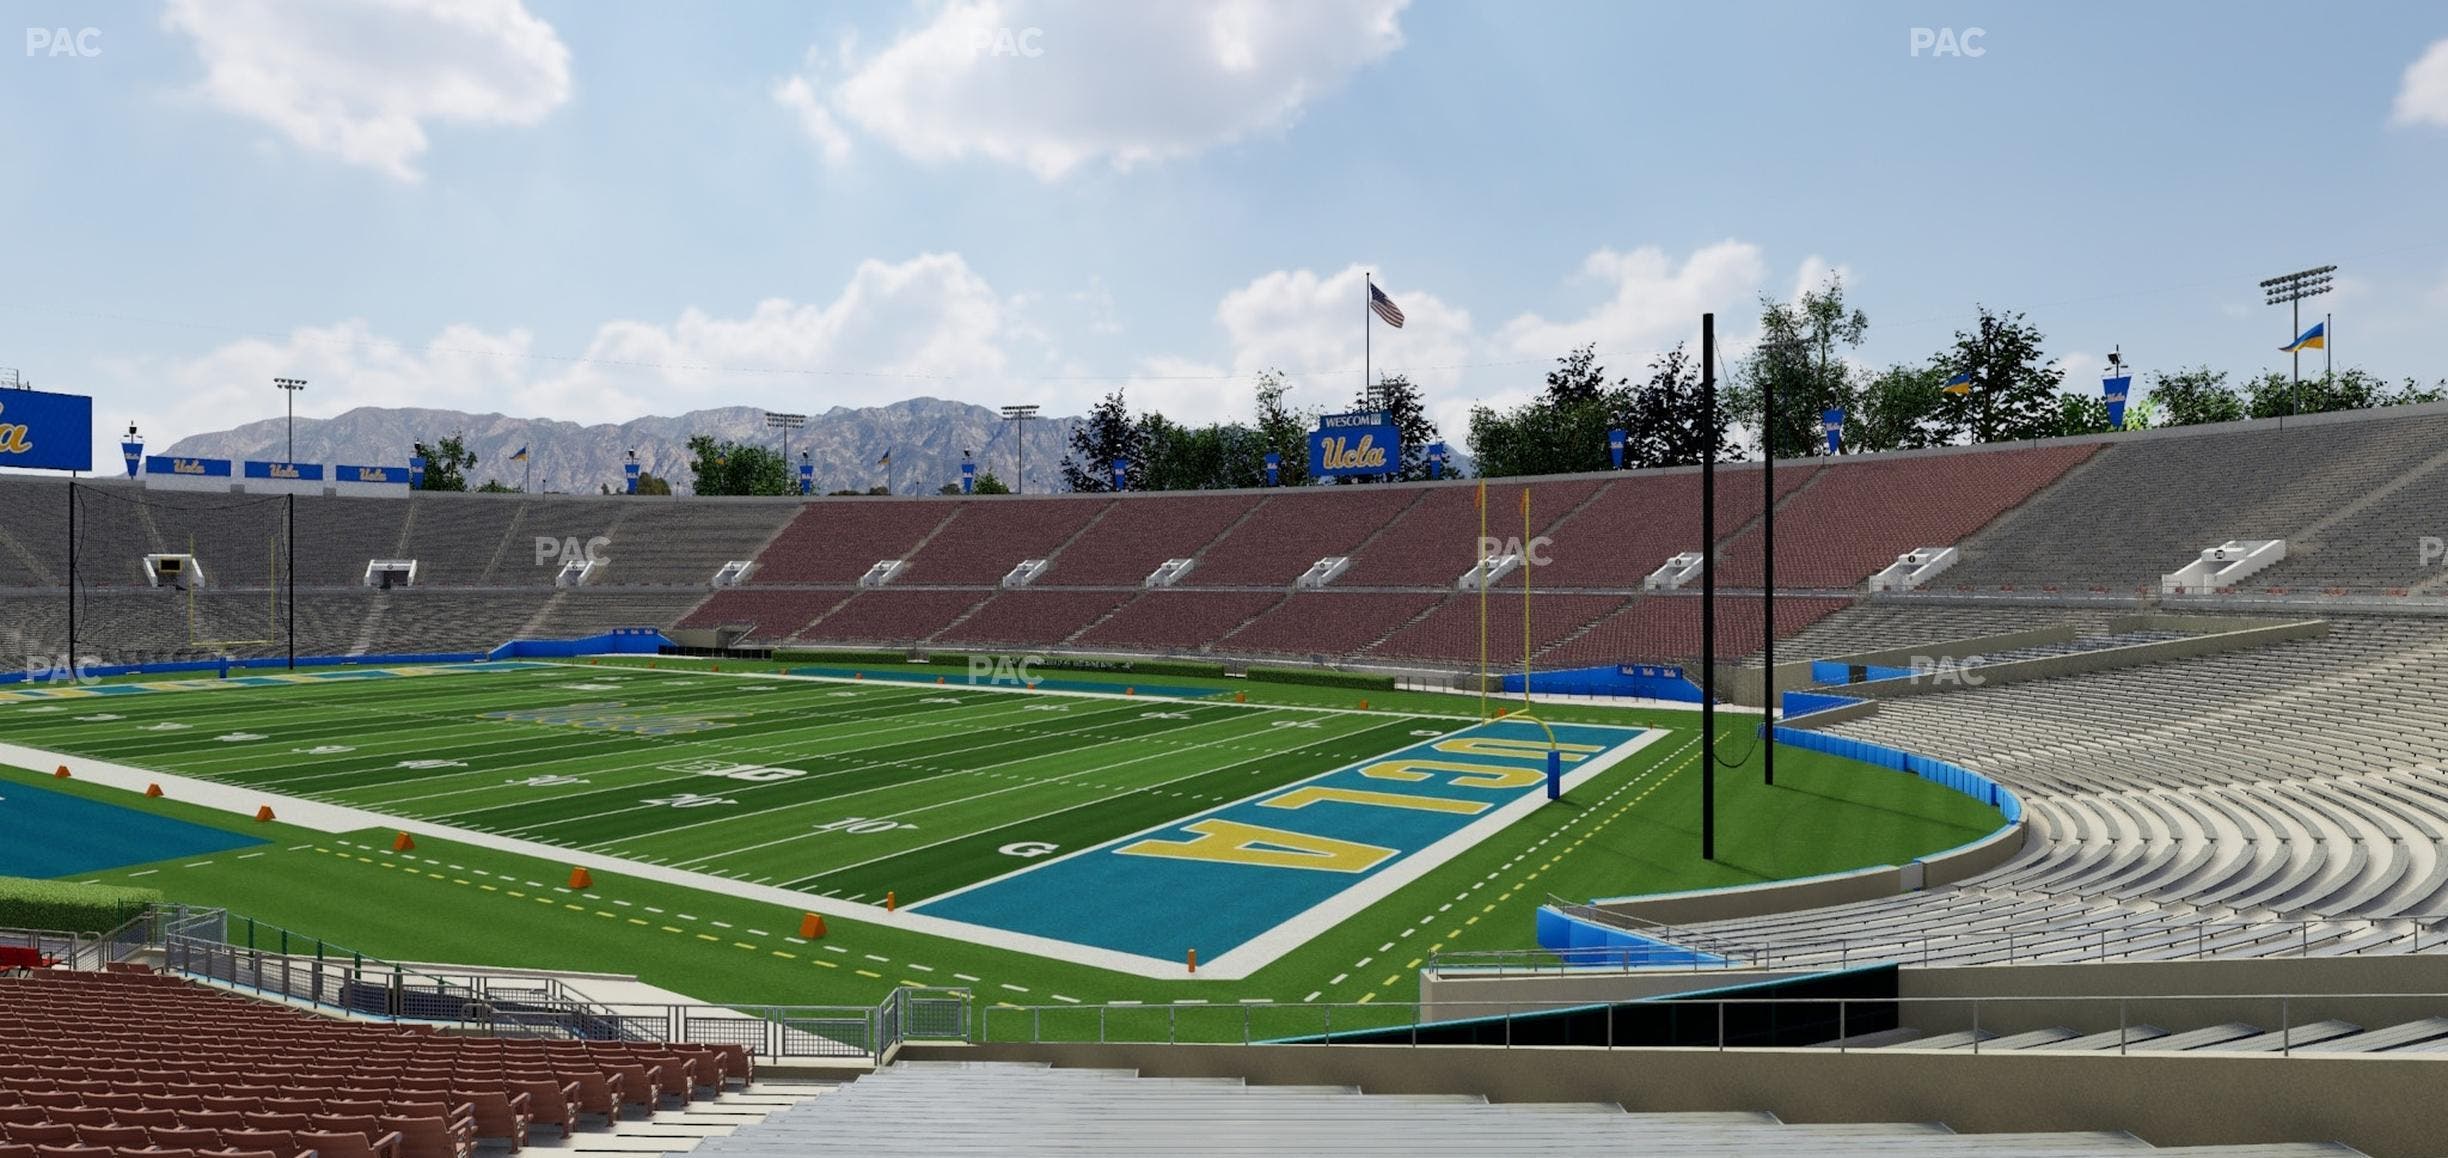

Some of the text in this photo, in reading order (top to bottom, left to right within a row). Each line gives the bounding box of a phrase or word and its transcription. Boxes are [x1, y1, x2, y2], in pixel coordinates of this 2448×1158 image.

[1325, 414, 1370, 428] WESCOM
[1111, 737, 1606, 873] UCLA
[812, 817, 899, 834] 10
[999, 841, 1060, 858] G
